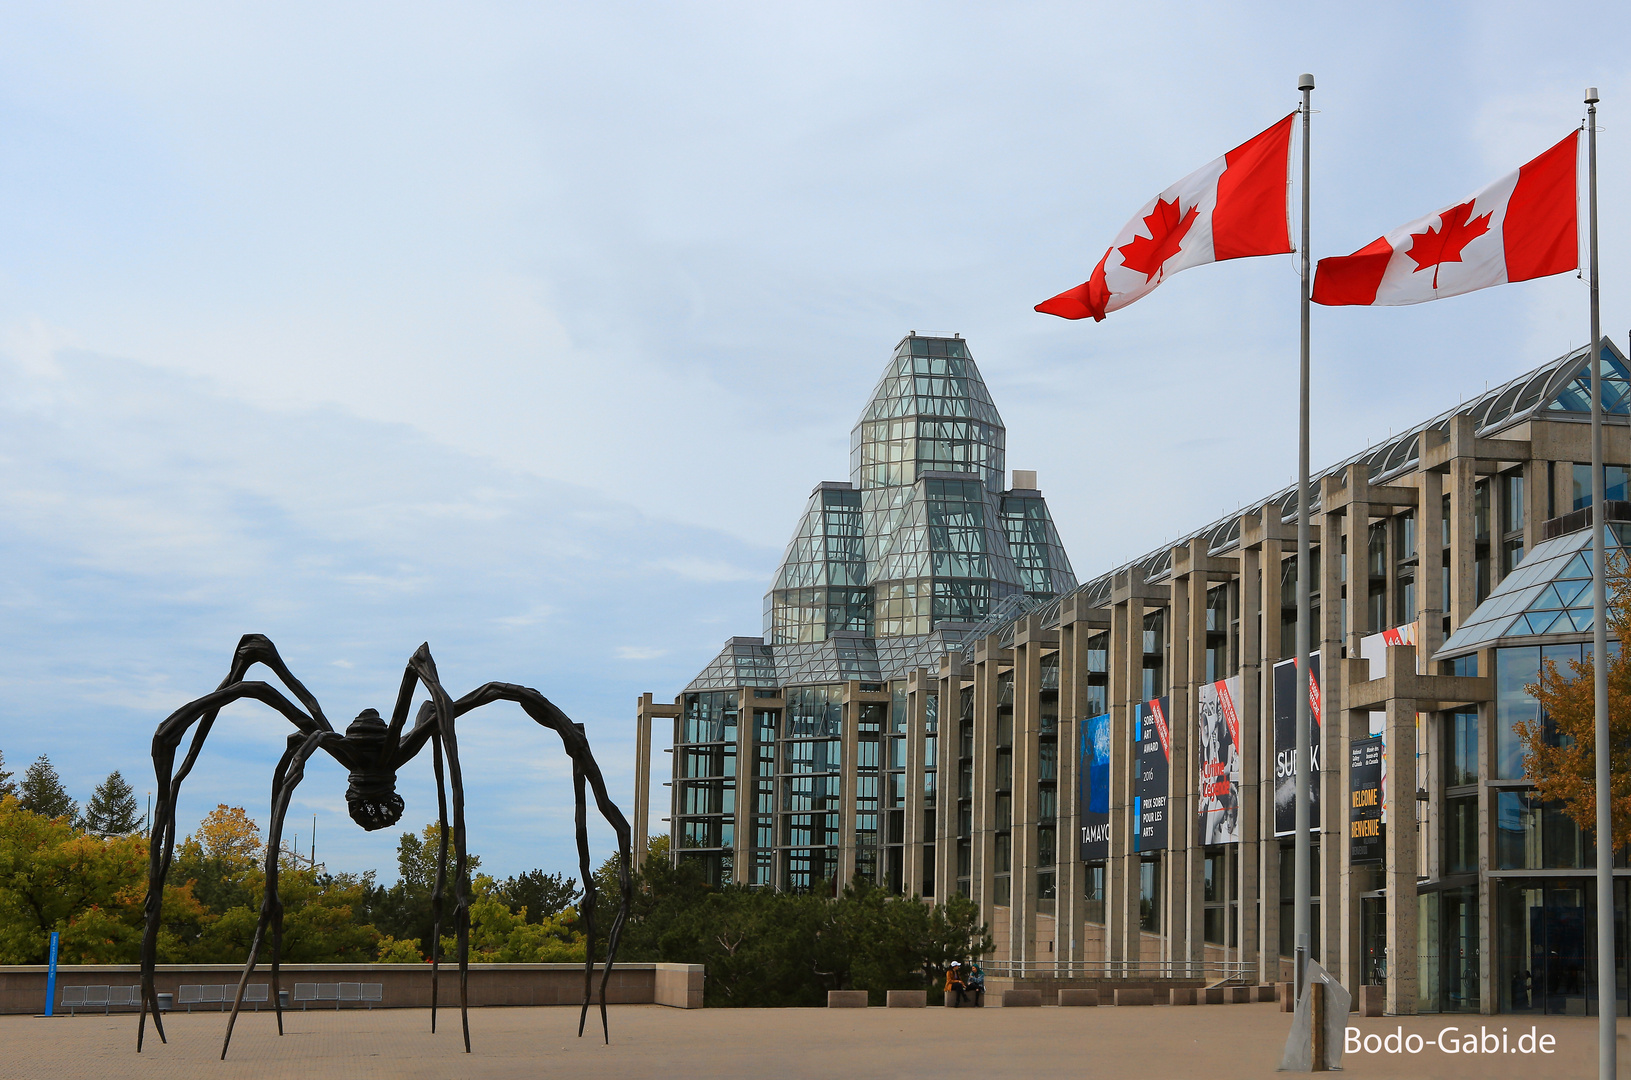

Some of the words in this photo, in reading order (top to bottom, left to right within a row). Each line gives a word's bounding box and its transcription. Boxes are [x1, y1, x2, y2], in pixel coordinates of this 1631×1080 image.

[1143, 714, 1154, 727] SOBE
[1143, 729, 1152, 741] ART
[1143, 741, 1159, 754] AWARD
[1277, 744, 1319, 778] SUK
[1143, 767, 1154, 782] 2016
[1143, 798, 1153, 810] PRIX
[1152, 796, 1167, 809] SOBEY
[1352, 789, 1378, 808] WELCOME
[1143, 812, 1154, 824] POUR
[1154, 811, 1162, 822] LES
[1142, 826, 1154, 837] ARTS
[1352, 819, 1379, 838] BIENVENUE
